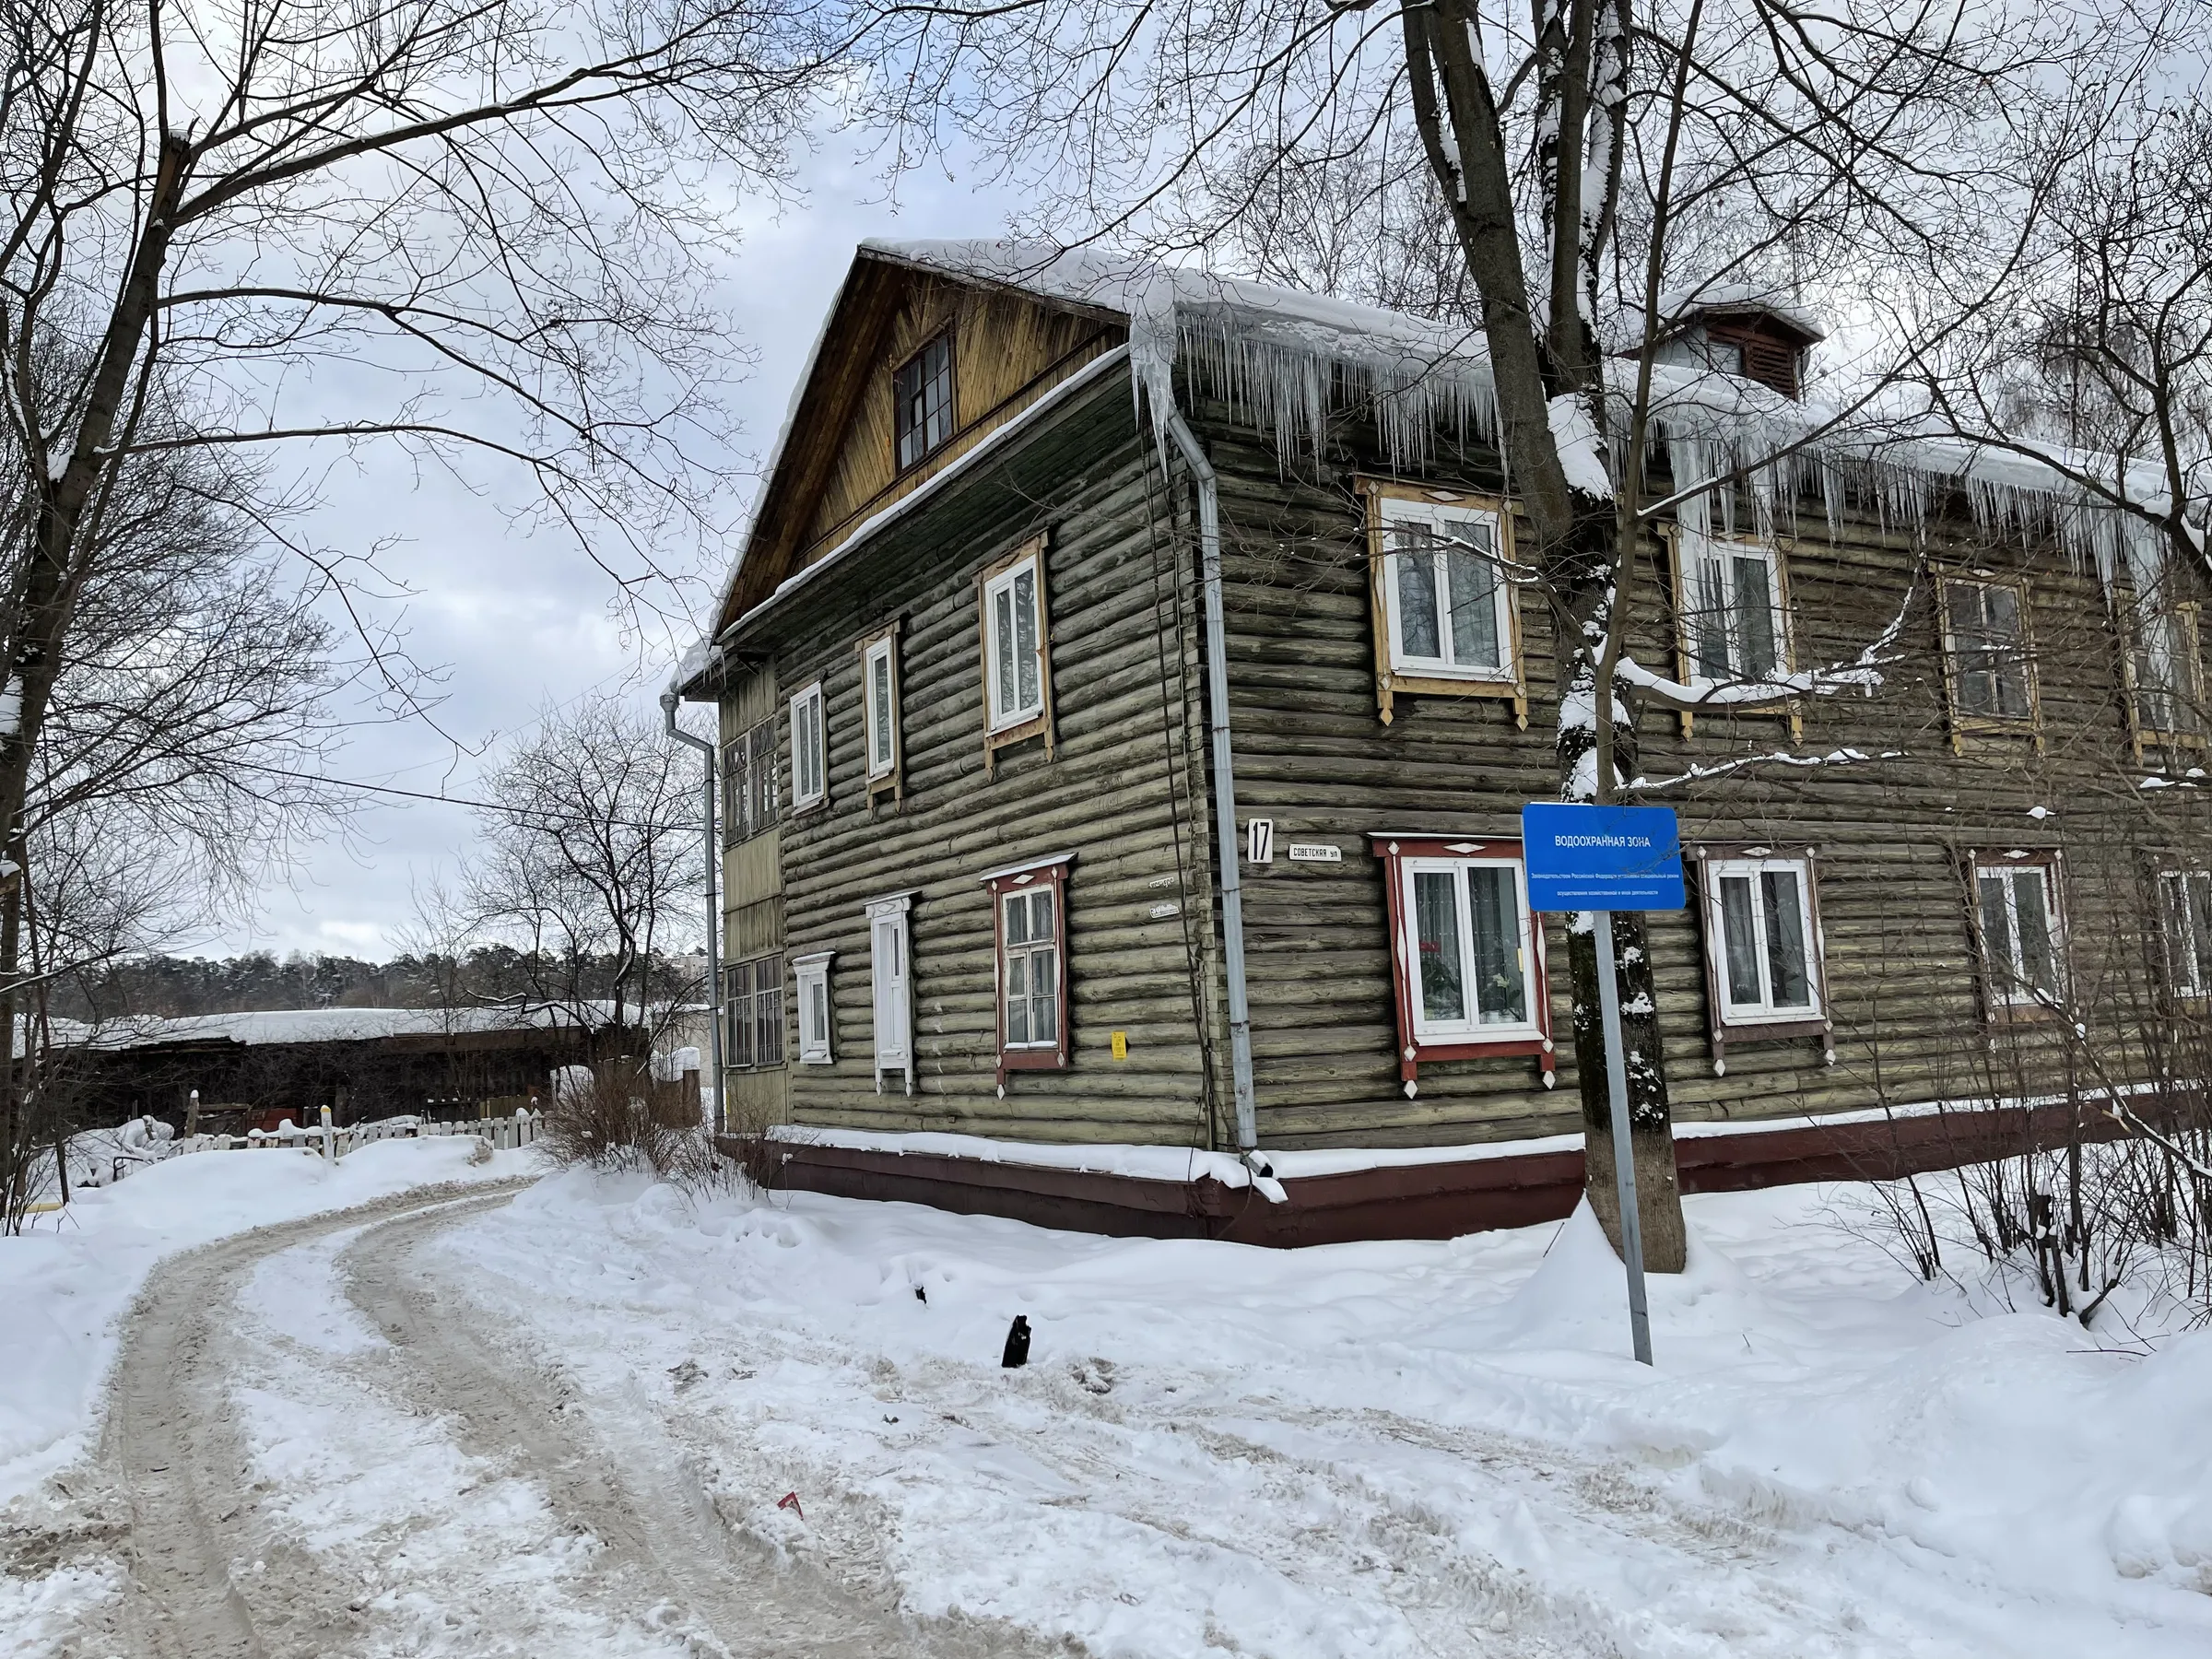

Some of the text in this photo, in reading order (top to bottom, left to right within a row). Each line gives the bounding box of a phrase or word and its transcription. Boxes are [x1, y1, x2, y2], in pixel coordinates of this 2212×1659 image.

[1253, 822, 1269, 860] 17
[1555, 835, 1651, 848] ВОДООХРАННАЯ ЗОНА
[1293, 848, 1327, 857] СОВЕТСКАЯ
